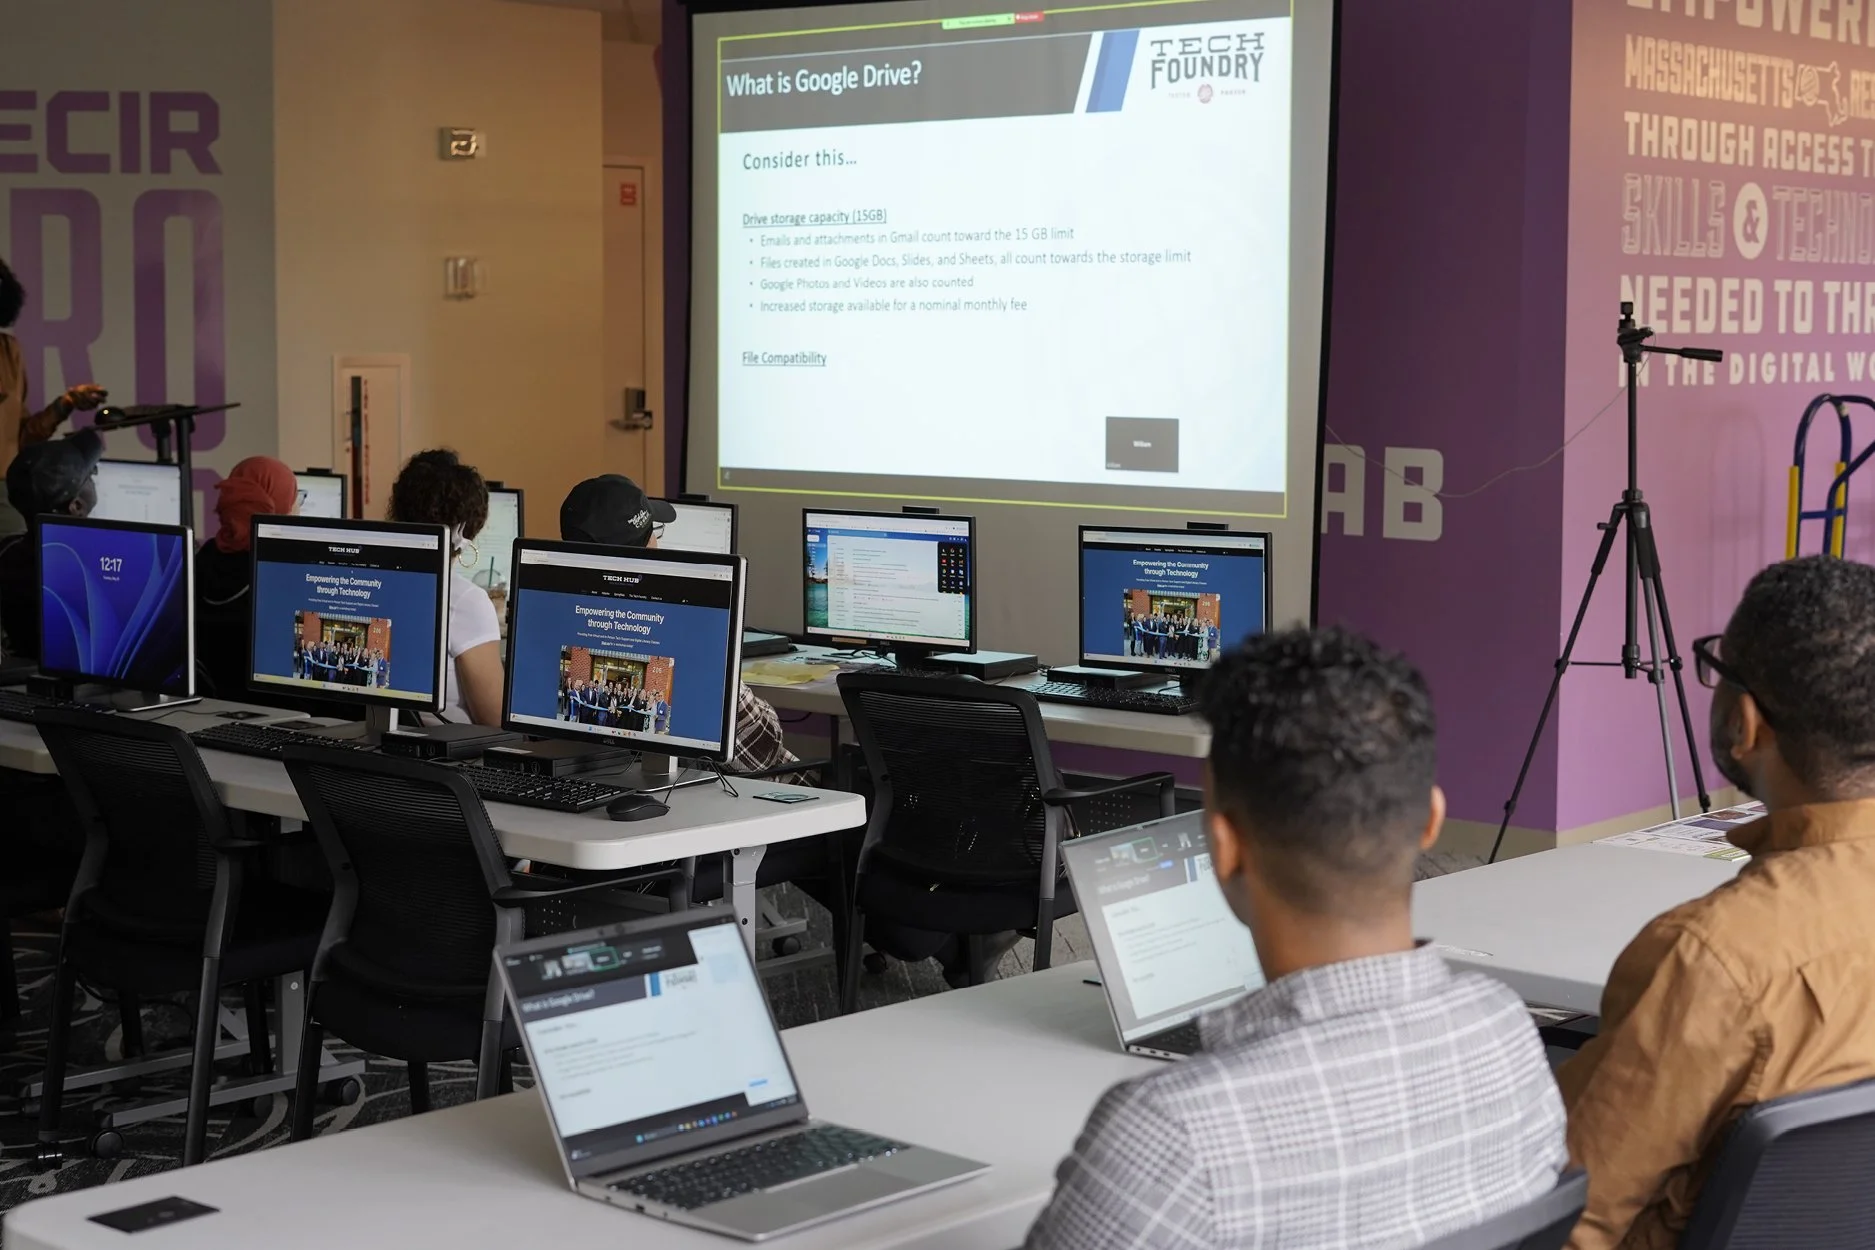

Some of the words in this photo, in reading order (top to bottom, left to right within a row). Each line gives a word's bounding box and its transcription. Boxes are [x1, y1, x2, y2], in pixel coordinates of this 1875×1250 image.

[1150, 32, 1264, 57] TECH
[726, 72, 774, 96] What
[778, 71, 792, 94] is
[795, 66, 858, 95] Google
[864, 60, 922, 88] Drive?
[1151, 52, 1264, 90] FOUNDRY
[1624, 34, 1794, 109] MASSACHUSETTS
[0, 90, 223, 175] ECIR
[1624, 111, 1754, 166] THROUGH
[1763, 127, 1854, 176] ACCESS
[1860, 138, 1875, 178] T
[743, 151, 810, 170] Consider
[742, 213, 768, 226] Drive
[770, 212, 806, 226] storage
[808, 211, 850, 226] capacity
[852, 208, 887, 224] (15GB)
[1621, 173, 1726, 258] SKILLS
[1772, 185, 1875, 265] TECHNO
[760, 234, 791, 246] Emails
[794, 233, 811, 246] and
[814, 232, 875, 245] attachments
[878, 232, 888, 244] in
[890, 230, 919, 244] Gmail
[922, 231, 951, 242] count
[954, 230, 991, 242] toward
[994, 230, 1012, 240] the
[1016, 228, 1028, 240] 15
[1032, 228, 1048, 240] GB
[1050, 227, 1074, 240] limit
[760, 256, 782, 268] Files
[784, 256, 820, 268] created
[822, 256, 832, 267] in
[834, 254, 868, 269] Google
[872, 254, 899, 268] Docs,
[902, 252, 934, 268] Slides,
[938, 253, 956, 266] and
[959, 252, 998, 267] Sheets,
[1000, 252, 1012, 264] all
[1015, 253, 1046, 264] count
[1050, 250, 1094, 264] towards
[1097, 250, 1116, 263] the
[1120, 250, 1162, 265] storage
[1164, 250, 1192, 262] limit
[760, 278, 794, 292] Google
[796, 278, 830, 290] Photos
[832, 277, 850, 289] and
[854, 276, 887, 288] Videos
[890, 278, 906, 288] are
[908, 276, 929, 288] also
[932, 276, 974, 288] counted
[760, 301, 806, 312] Increased
[808, 300, 844, 314] storage
[846, 299, 890, 312] available
[893, 298, 907, 312] for
[920, 298, 960, 310] nominal
[964, 298, 1007, 312] monthly
[1010, 298, 1028, 310] fee
[1620, 274, 1764, 334] NEEDED
[1774, 280, 1813, 334] TO
[9, 188, 226, 452] RO
[742, 352, 759, 364] File
[762, 352, 826, 366] Compatibility
[1666, 352, 1714, 386] THE
[1730, 352, 1834, 385] DIGITAL
[1321, 443, 1444, 542] AB
[100, 557, 122, 572] 12:17
[1133, 560, 1166, 568] Empowering
[1176, 561, 1208, 570] Community
[1144, 568, 1166, 576] through
[1166, 569, 1198, 578] Technology
[306, 574, 340, 586] Empowering
[340, 575, 350, 585] the
[350, 577, 382, 590] Community
[316, 586, 338, 596] through
[339, 587, 371, 599] Technology
[576, 605, 614, 620] Empowering
[616, 610, 626, 618] the
[626, 611, 664, 624] Community
[588, 619, 612, 630] through
[614, 622, 651, 634] Technology
